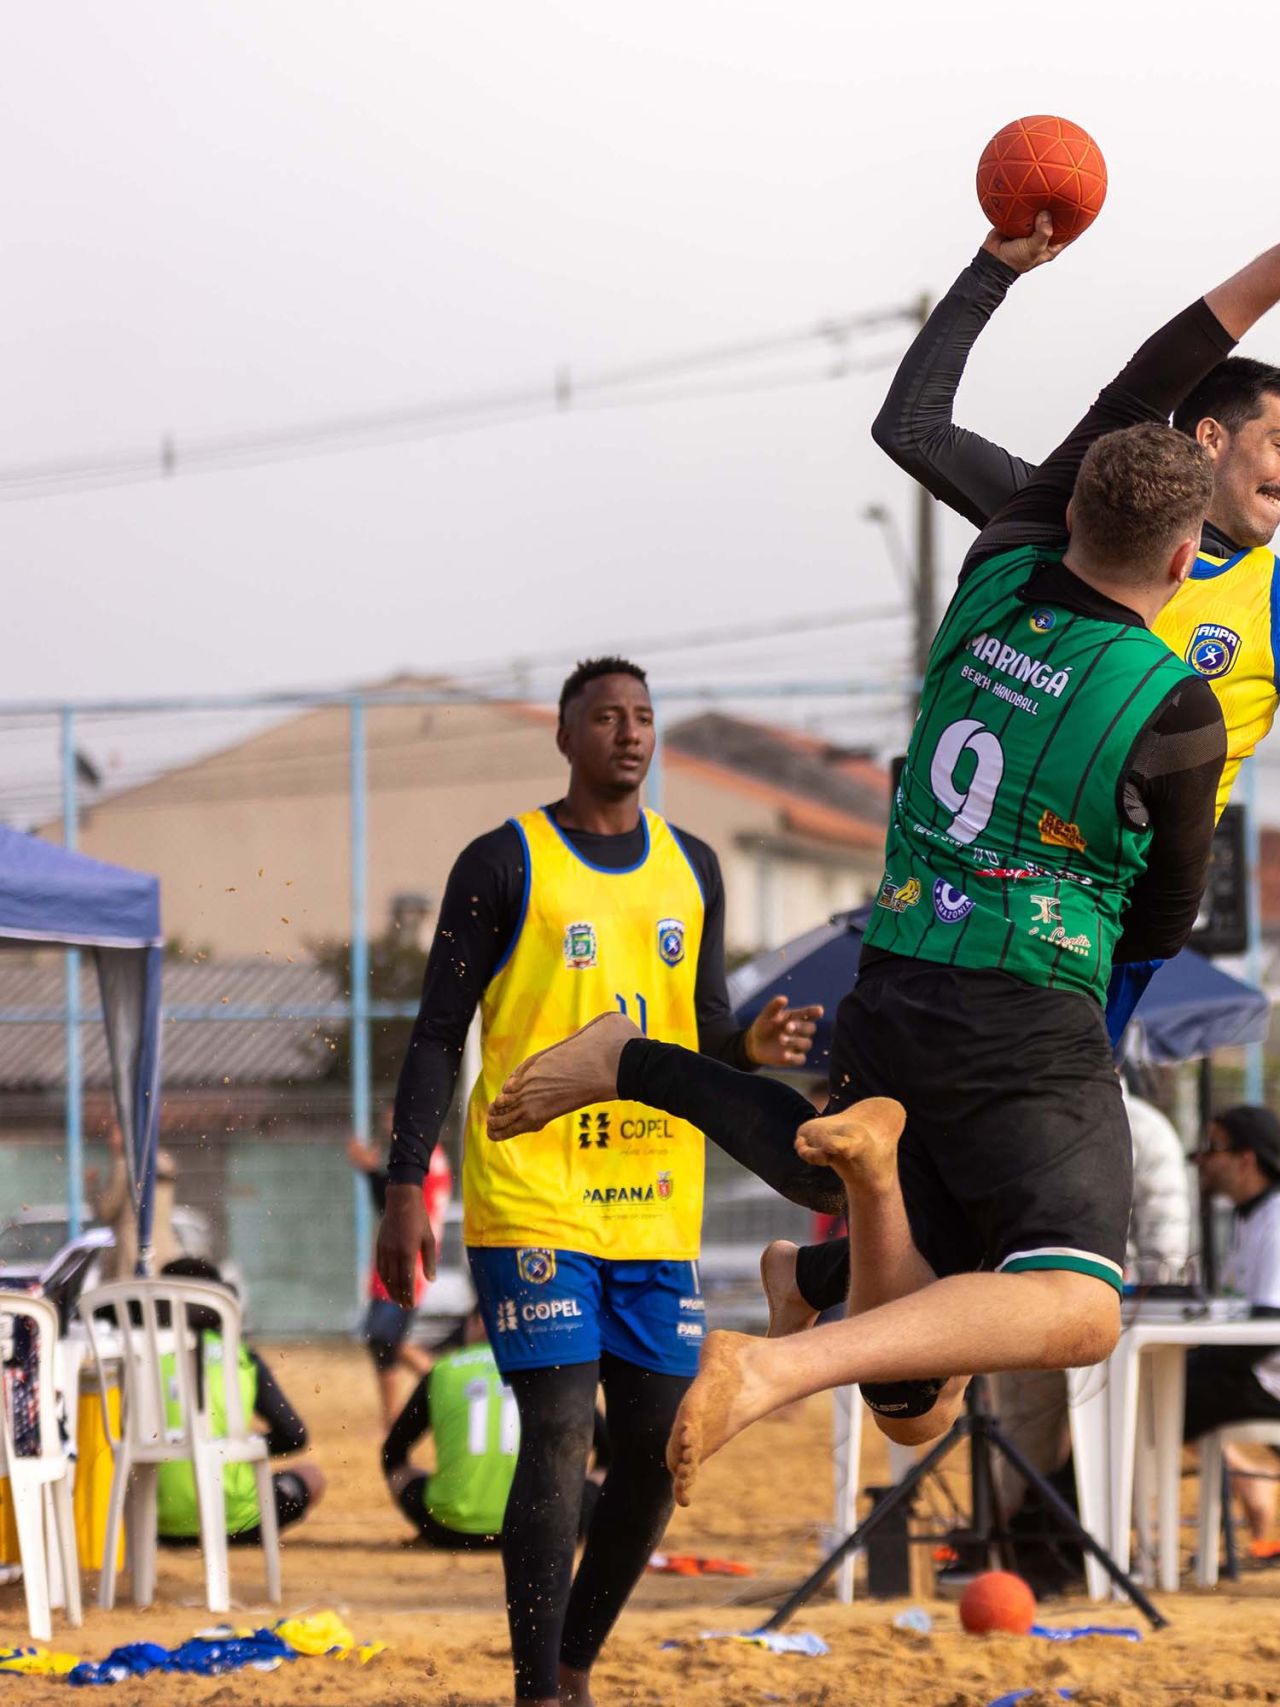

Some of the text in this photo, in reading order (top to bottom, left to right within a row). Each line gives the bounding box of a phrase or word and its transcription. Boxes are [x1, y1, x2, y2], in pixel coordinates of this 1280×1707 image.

[1197, 626, 1238, 647] AHPA
[966, 632, 1073, 698] MARINGÁ
[961, 665, 1039, 715] BEACH HANDBALL
[931, 719, 1005, 844] 9
[620, 1119, 674, 1140] COPEL
[583, 1184, 655, 1203] PARANÁ
[522, 1299, 582, 1321] COPEL
[465, 1376, 517, 1456] 11
